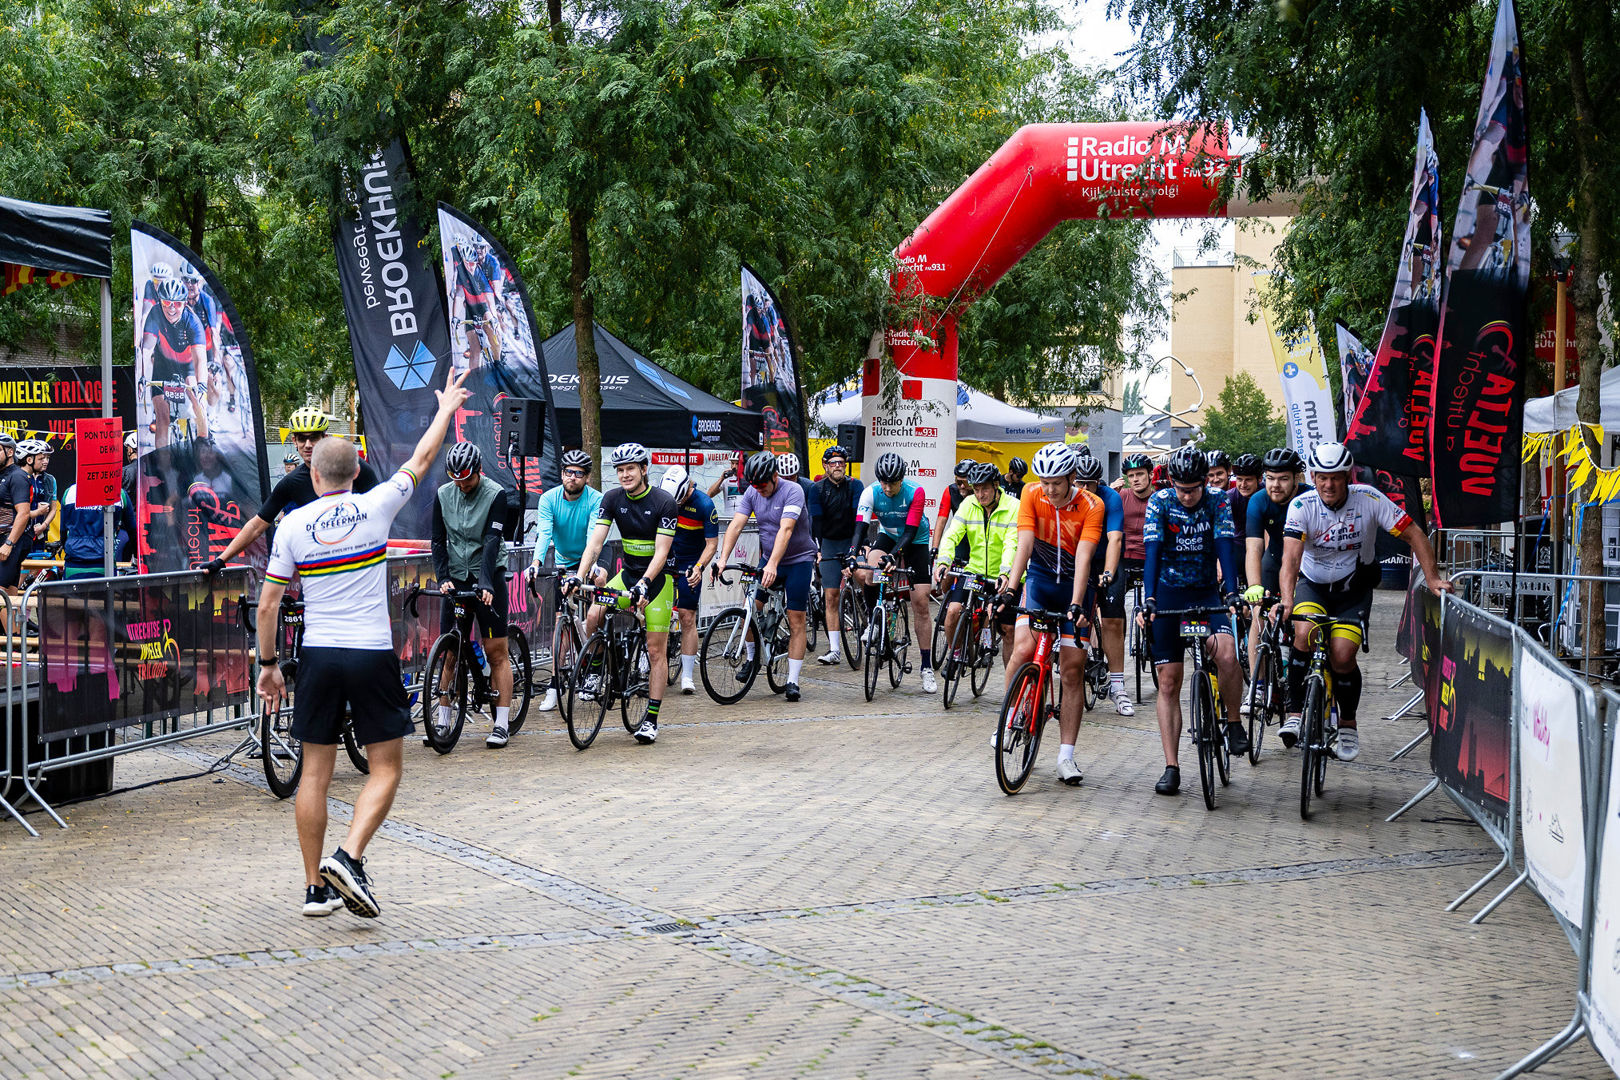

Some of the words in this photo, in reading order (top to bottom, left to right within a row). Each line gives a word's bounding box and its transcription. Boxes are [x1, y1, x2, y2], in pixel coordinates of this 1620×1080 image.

[1082, 135, 1149, 156] Radio
[1160, 135, 1186, 155] M
[1081, 158, 1177, 181] Utrecht
[917, 254, 927, 263] M
[897, 263, 924, 272] trecht
[1540, 339, 1577, 348] Utrht
[0, 380, 52, 404] WIELER
[53, 380, 118, 404] TRILOGE
[876, 416, 903, 426] Radio
[905, 416, 918, 427] M
[84, 431, 98, 440] PON
[99, 430, 108, 440] TU
[875, 426, 913, 437] Utrecht
[1005, 427, 1025, 435] Eerste
[1026, 427, 1041, 435] Hulp
[876, 440, 937, 449] www.rtvutrecht.nl
[99, 445, 108, 454] DE
[657, 454, 669, 464] 110
[669, 455, 682, 464] KM
[707, 453, 729, 462] VUELTA
[910, 459, 920, 468] M
[86, 471, 100, 481] ZET
[101, 470, 109, 480] JE
[103, 484, 114, 494] OP
[305, 523, 317, 532] DE
[1175, 536, 1203, 546] lease
[598, 595, 615, 604] 1372
[1033, 622, 1048, 630] 234
[1184, 625, 1207, 633] 2119
